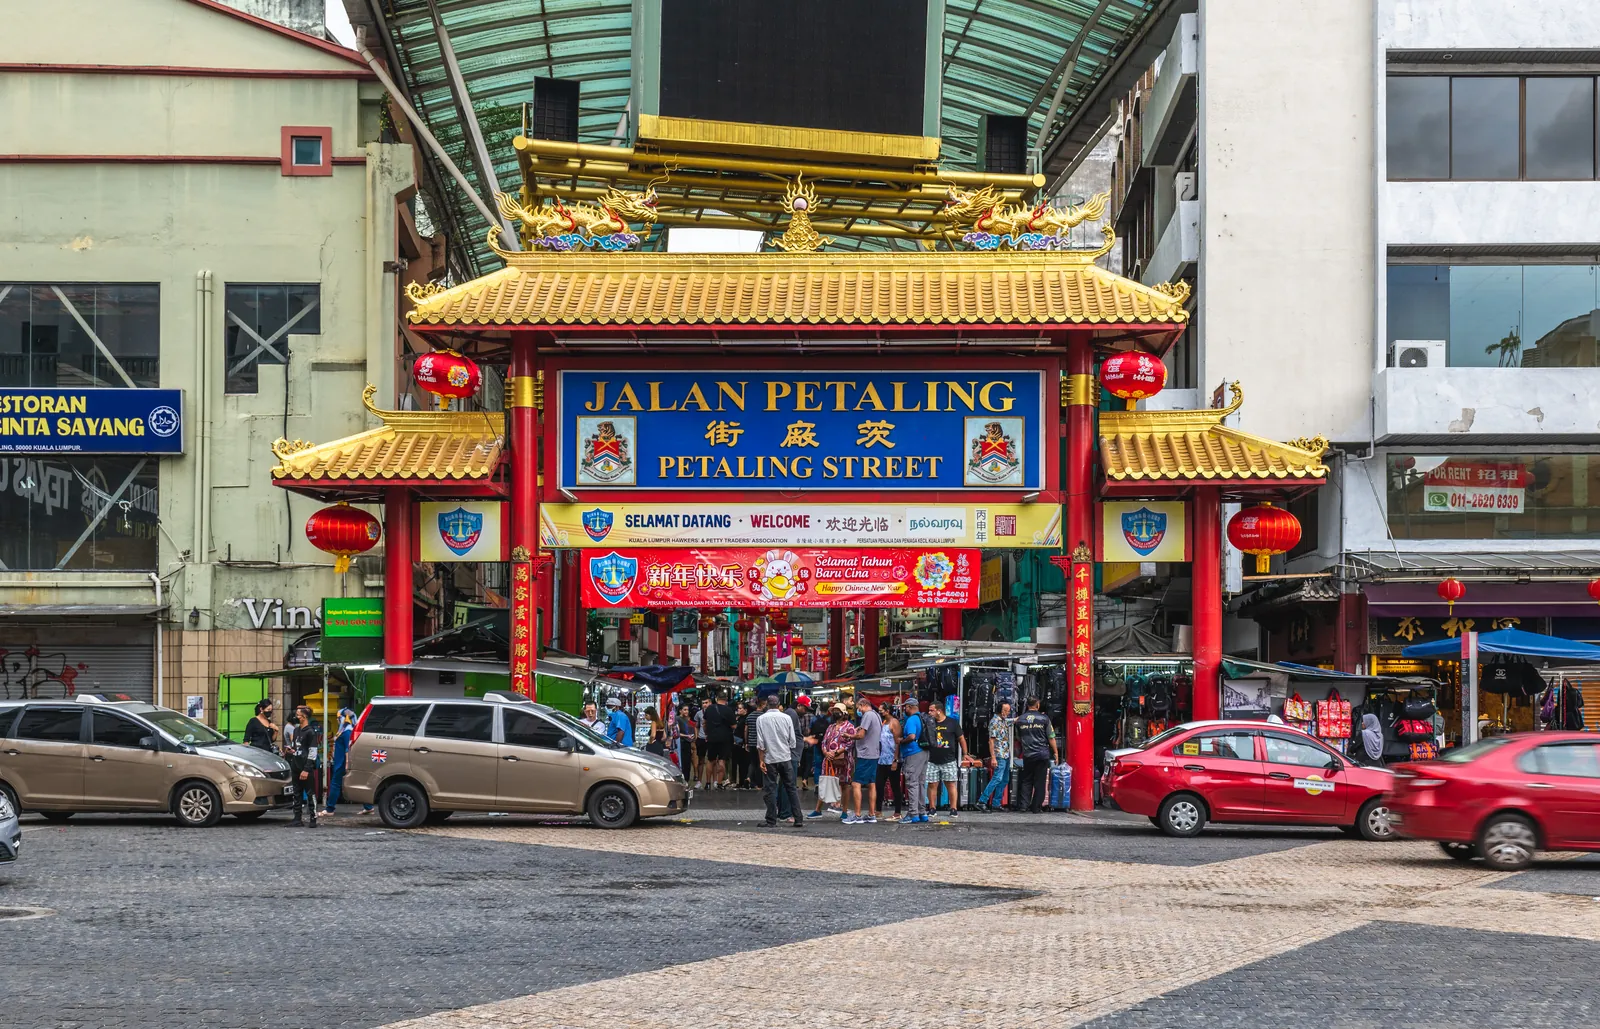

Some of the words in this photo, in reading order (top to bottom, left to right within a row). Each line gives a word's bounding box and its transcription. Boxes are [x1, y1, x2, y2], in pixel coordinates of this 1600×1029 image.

[584, 381, 749, 412] JALAN
[763, 380, 1017, 413] PETALING
[0, 417, 51, 436] INTA
[57, 417, 145, 436] SAYANG
[658, 456, 814, 478] PETALING
[822, 455, 943, 478] STREET
[1428, 467, 1446, 479] FOR
[1448, 467, 1471, 480] RENT
[1478, 469, 1519, 480] 招租
[1451, 493, 1494, 508] 011-2620
[1497, 494, 1519, 509] 6339
[625, 514, 680, 528] SELAMAT
[683, 514, 731, 528] DATANG
[751, 514, 811, 529] WELCOME
[825, 515, 889, 532] 欢迎光临
[909, 517, 963, 531] நல்வரவு
[975, 509, 987, 542] 丙申年
[815, 556, 858, 567] Selamat
[861, 556, 893, 567] Tahun
[647, 563, 745, 590] 新年快乐
[815, 567, 842, 579] Baru
[844, 567, 869, 579] Cina
[821, 584, 843, 593] Happy
[844, 584, 869, 592] Chinese
[871, 584, 886, 592] New
[887, 584, 902, 592] Year
